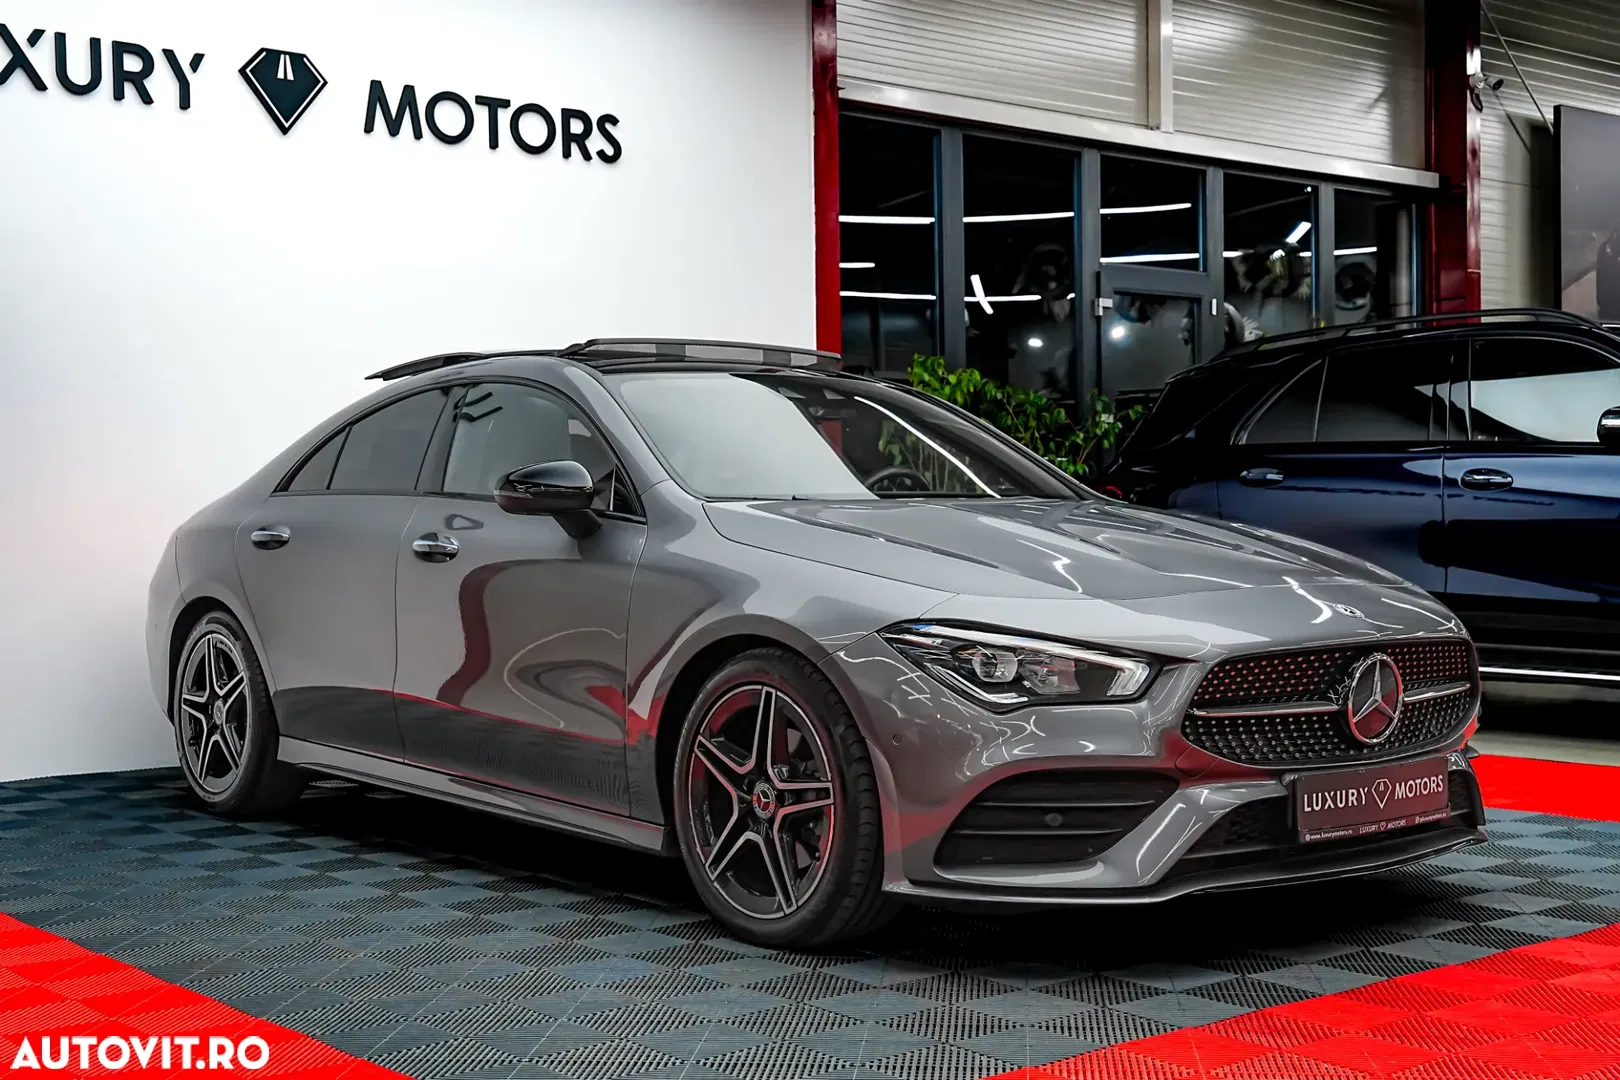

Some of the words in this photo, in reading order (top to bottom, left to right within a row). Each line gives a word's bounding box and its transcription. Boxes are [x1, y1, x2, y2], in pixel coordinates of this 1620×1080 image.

[0, 23, 205, 110] XURY
[364, 79, 623, 164] MOTORS
[1303, 787, 1368, 812] LUXURY
[1394, 775, 1444, 800] MOTORS
[1360, 825, 1378, 834] LUXURY
[1387, 819, 1407, 829] MOTORS
